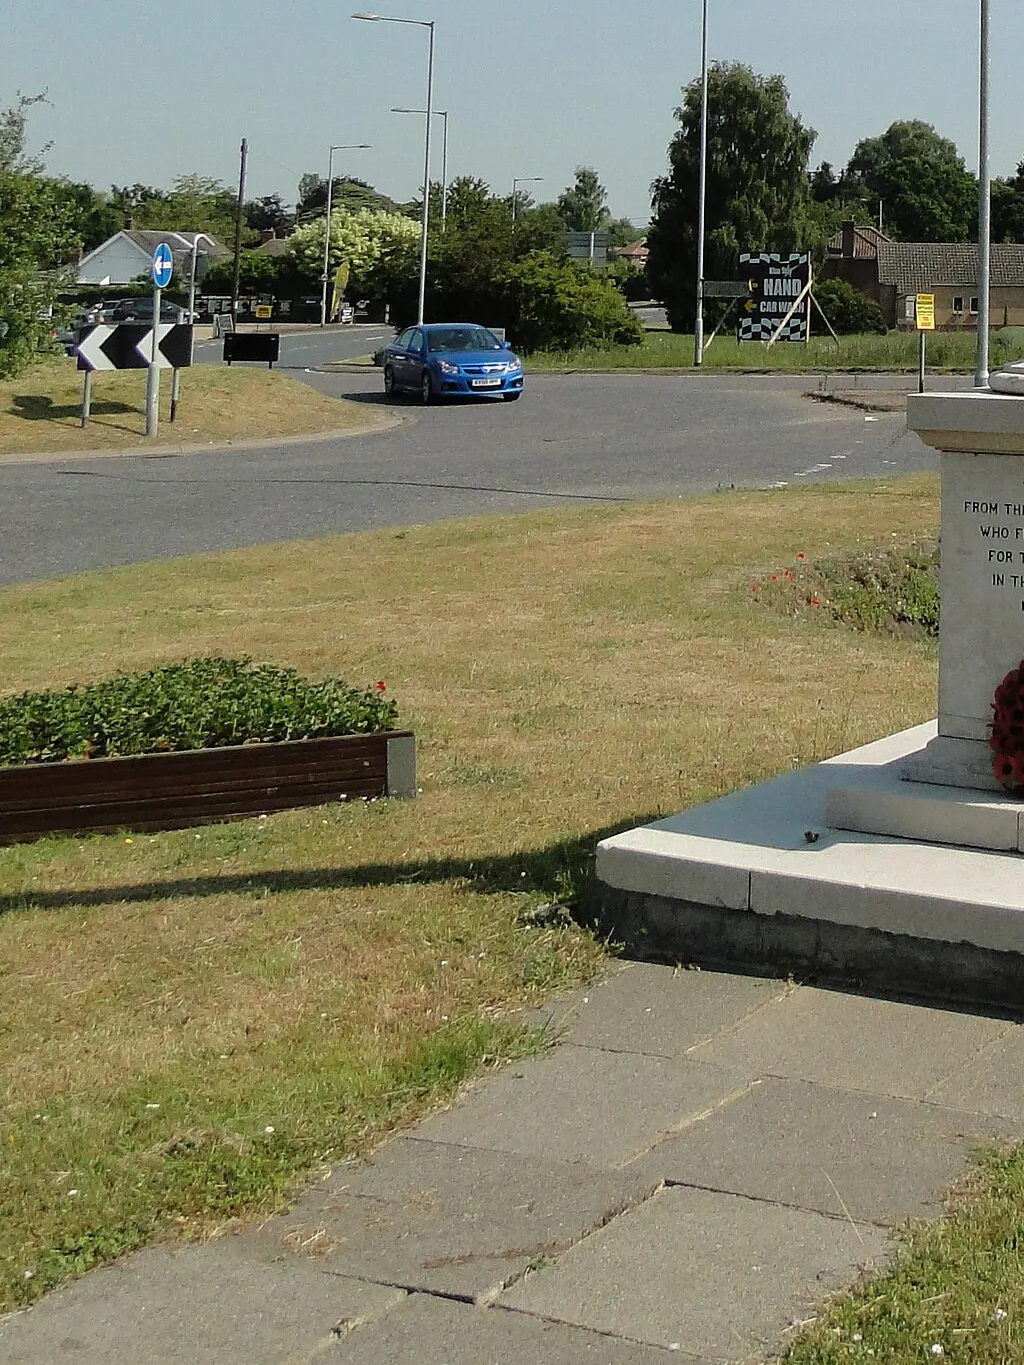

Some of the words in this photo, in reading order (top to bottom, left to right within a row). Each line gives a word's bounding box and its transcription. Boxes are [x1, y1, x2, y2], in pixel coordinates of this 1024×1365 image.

[764, 279, 802, 296] HAND
[760, 301, 777, 312] CAR
[779, 302, 804, 313] WAH
[964, 501, 998, 515] FROM
[980, 525, 1010, 538] WHO
[988, 550, 1013, 563] FOR
[992, 574, 1004, 586] IN
